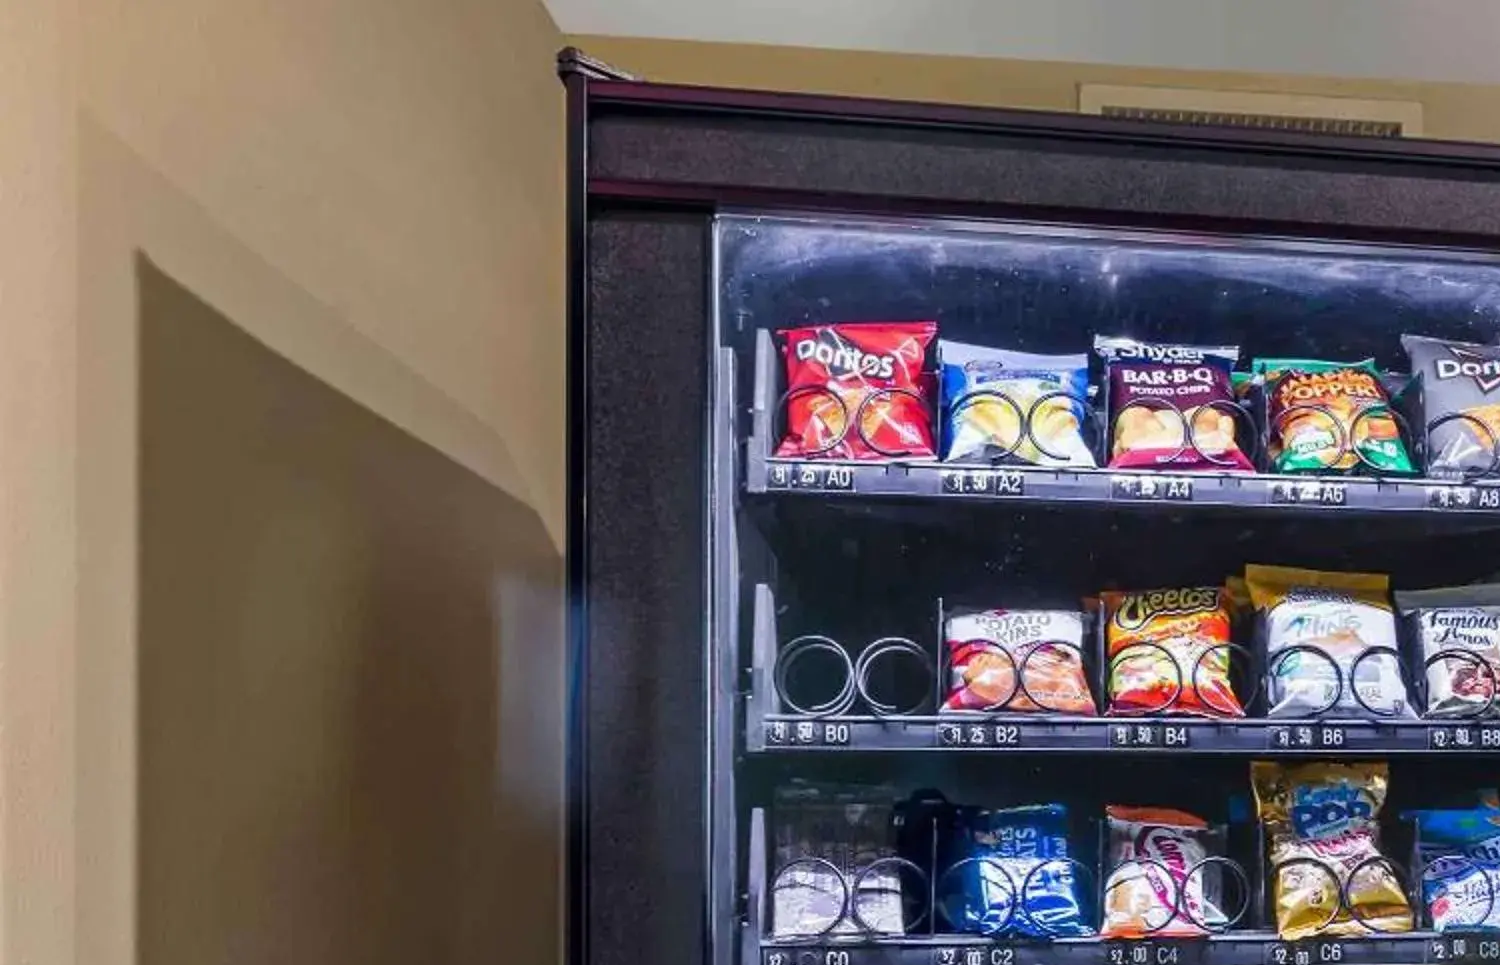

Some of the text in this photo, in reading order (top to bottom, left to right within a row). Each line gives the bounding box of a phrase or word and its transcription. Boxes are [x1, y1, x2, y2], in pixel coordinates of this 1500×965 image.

[796, 339, 894, 378] Doritos
[1129, 386, 1174, 396] POTATO
[999, 473, 1021, 492] A2
[1480, 489, 1499, 507] A8
[1115, 587, 1219, 630] Cheetos
[975, 614, 1051, 631] POTATO
[1429, 611, 1500, 630] Famous
[1434, 628, 1494, 646] Amos
[825, 725, 848, 743] B0
[996, 726, 1018, 744] B2
[1165, 728, 1187, 744] B4
[1322, 729, 1343, 745] B6
[1157, 948, 1178, 964] C4
[1321, 945, 1341, 961] C6
